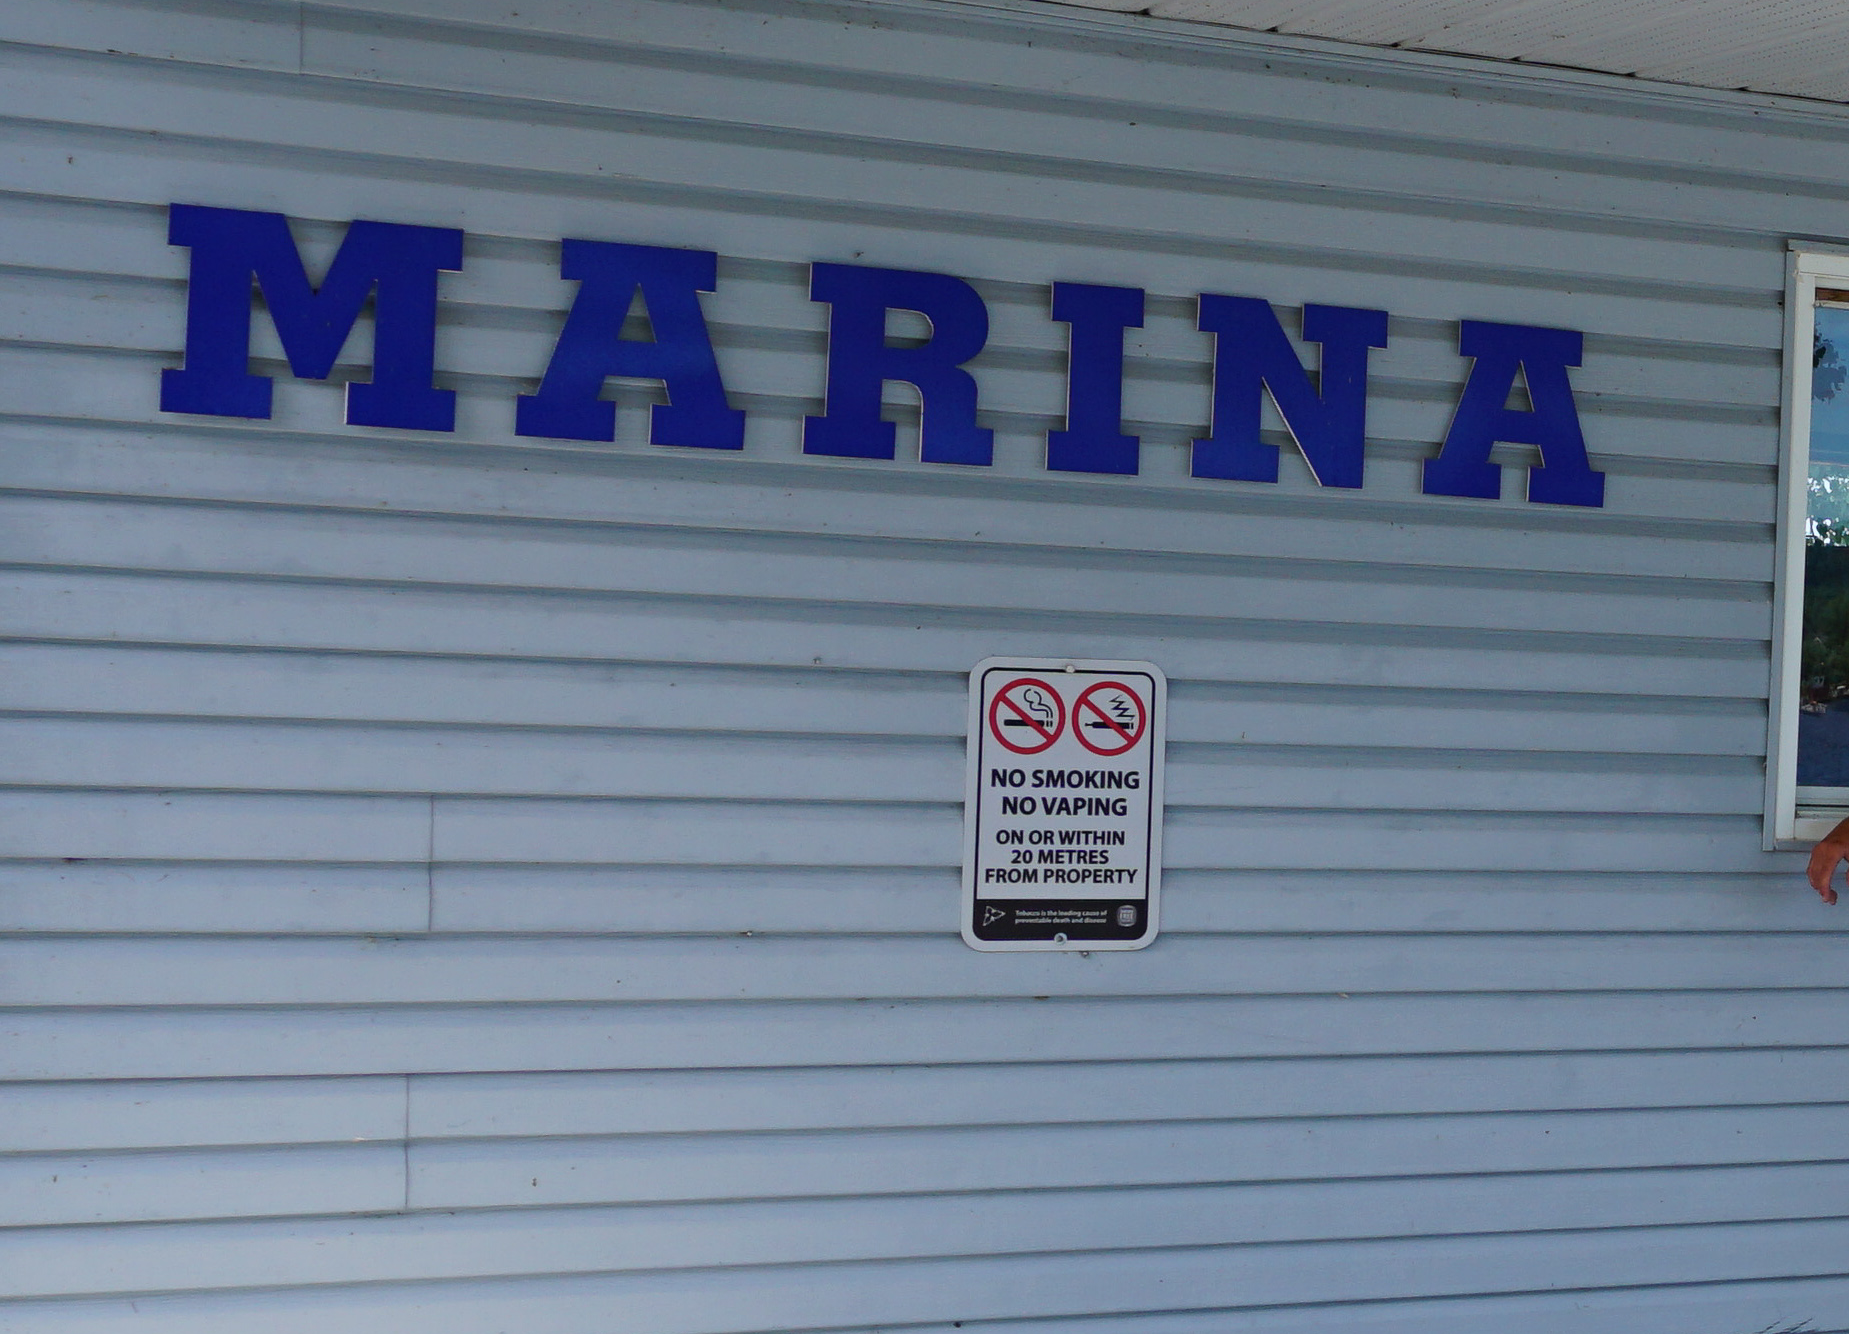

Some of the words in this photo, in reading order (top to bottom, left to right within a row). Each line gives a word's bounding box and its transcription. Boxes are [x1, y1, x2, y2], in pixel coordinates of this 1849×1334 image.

[159, 202, 1606, 508] MARINA
[991, 769, 1026, 787] NO
[1031, 769, 1140, 789] SMOKING
[1002, 796, 1036, 815] NO
[1041, 797, 1128, 816] VAPING
[996, 829, 1024, 845] ON
[1028, 830, 1054, 845] OR
[1058, 830, 1125, 845] WITHIN
[1011, 850, 1033, 864] 20
[1038, 850, 1109, 864] METRES
[985, 868, 1038, 883] FROM
[1043, 869, 1138, 883] PROPERTY
